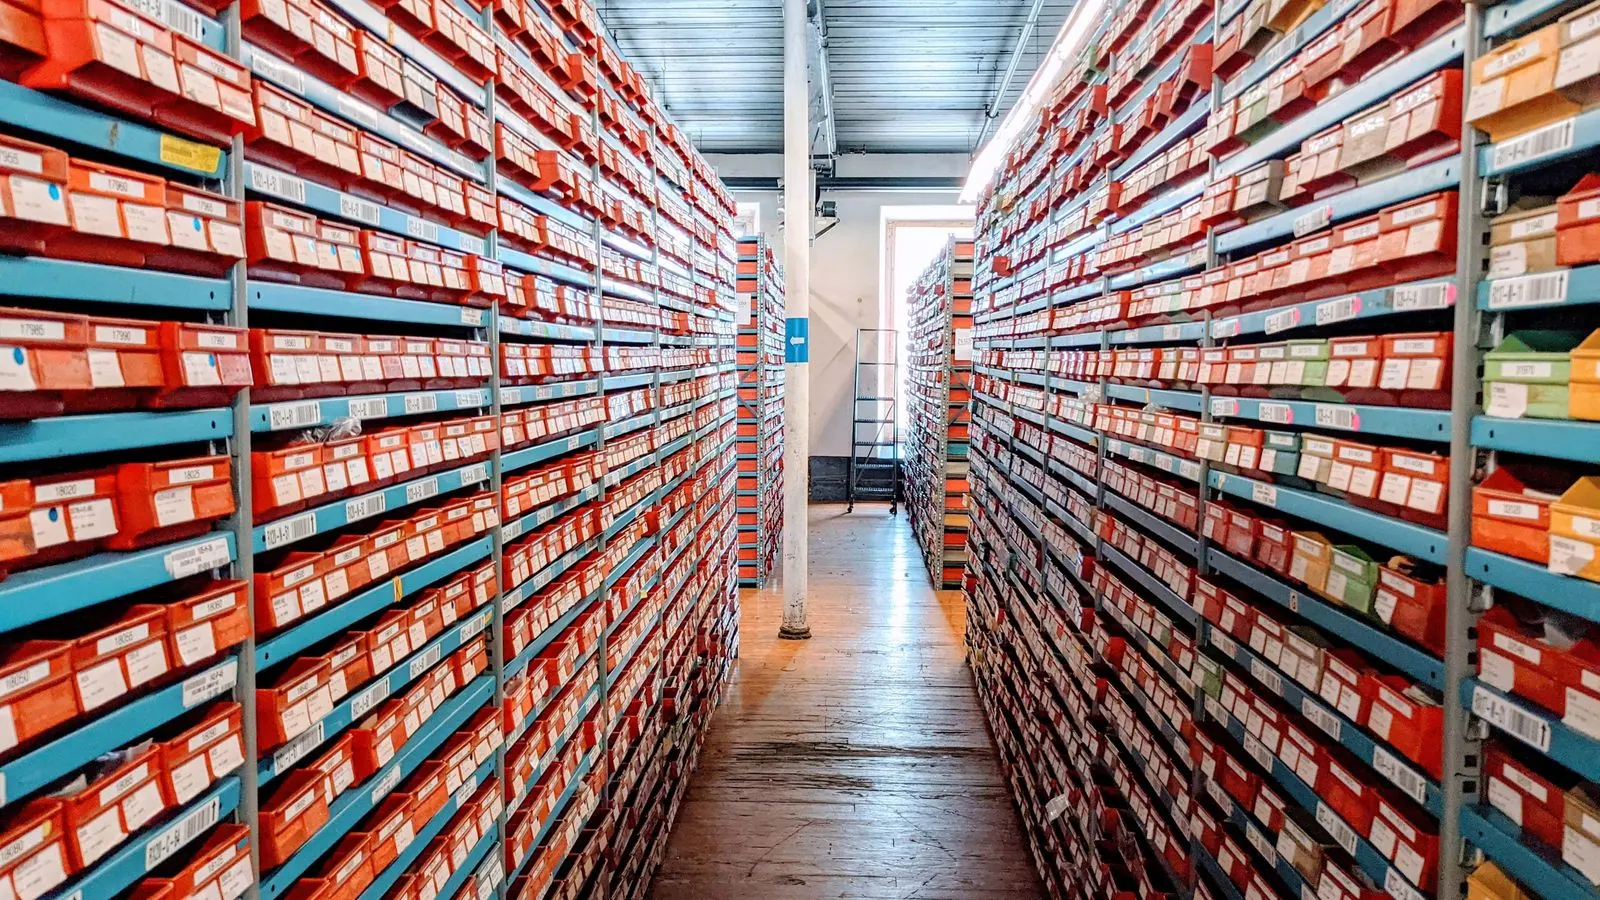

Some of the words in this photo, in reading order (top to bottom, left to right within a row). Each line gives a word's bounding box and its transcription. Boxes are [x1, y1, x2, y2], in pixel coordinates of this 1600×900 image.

[107, 179, 129, 193] 17960
[183, 469, 201, 481] 18025
[55, 484, 77, 497] 18020
